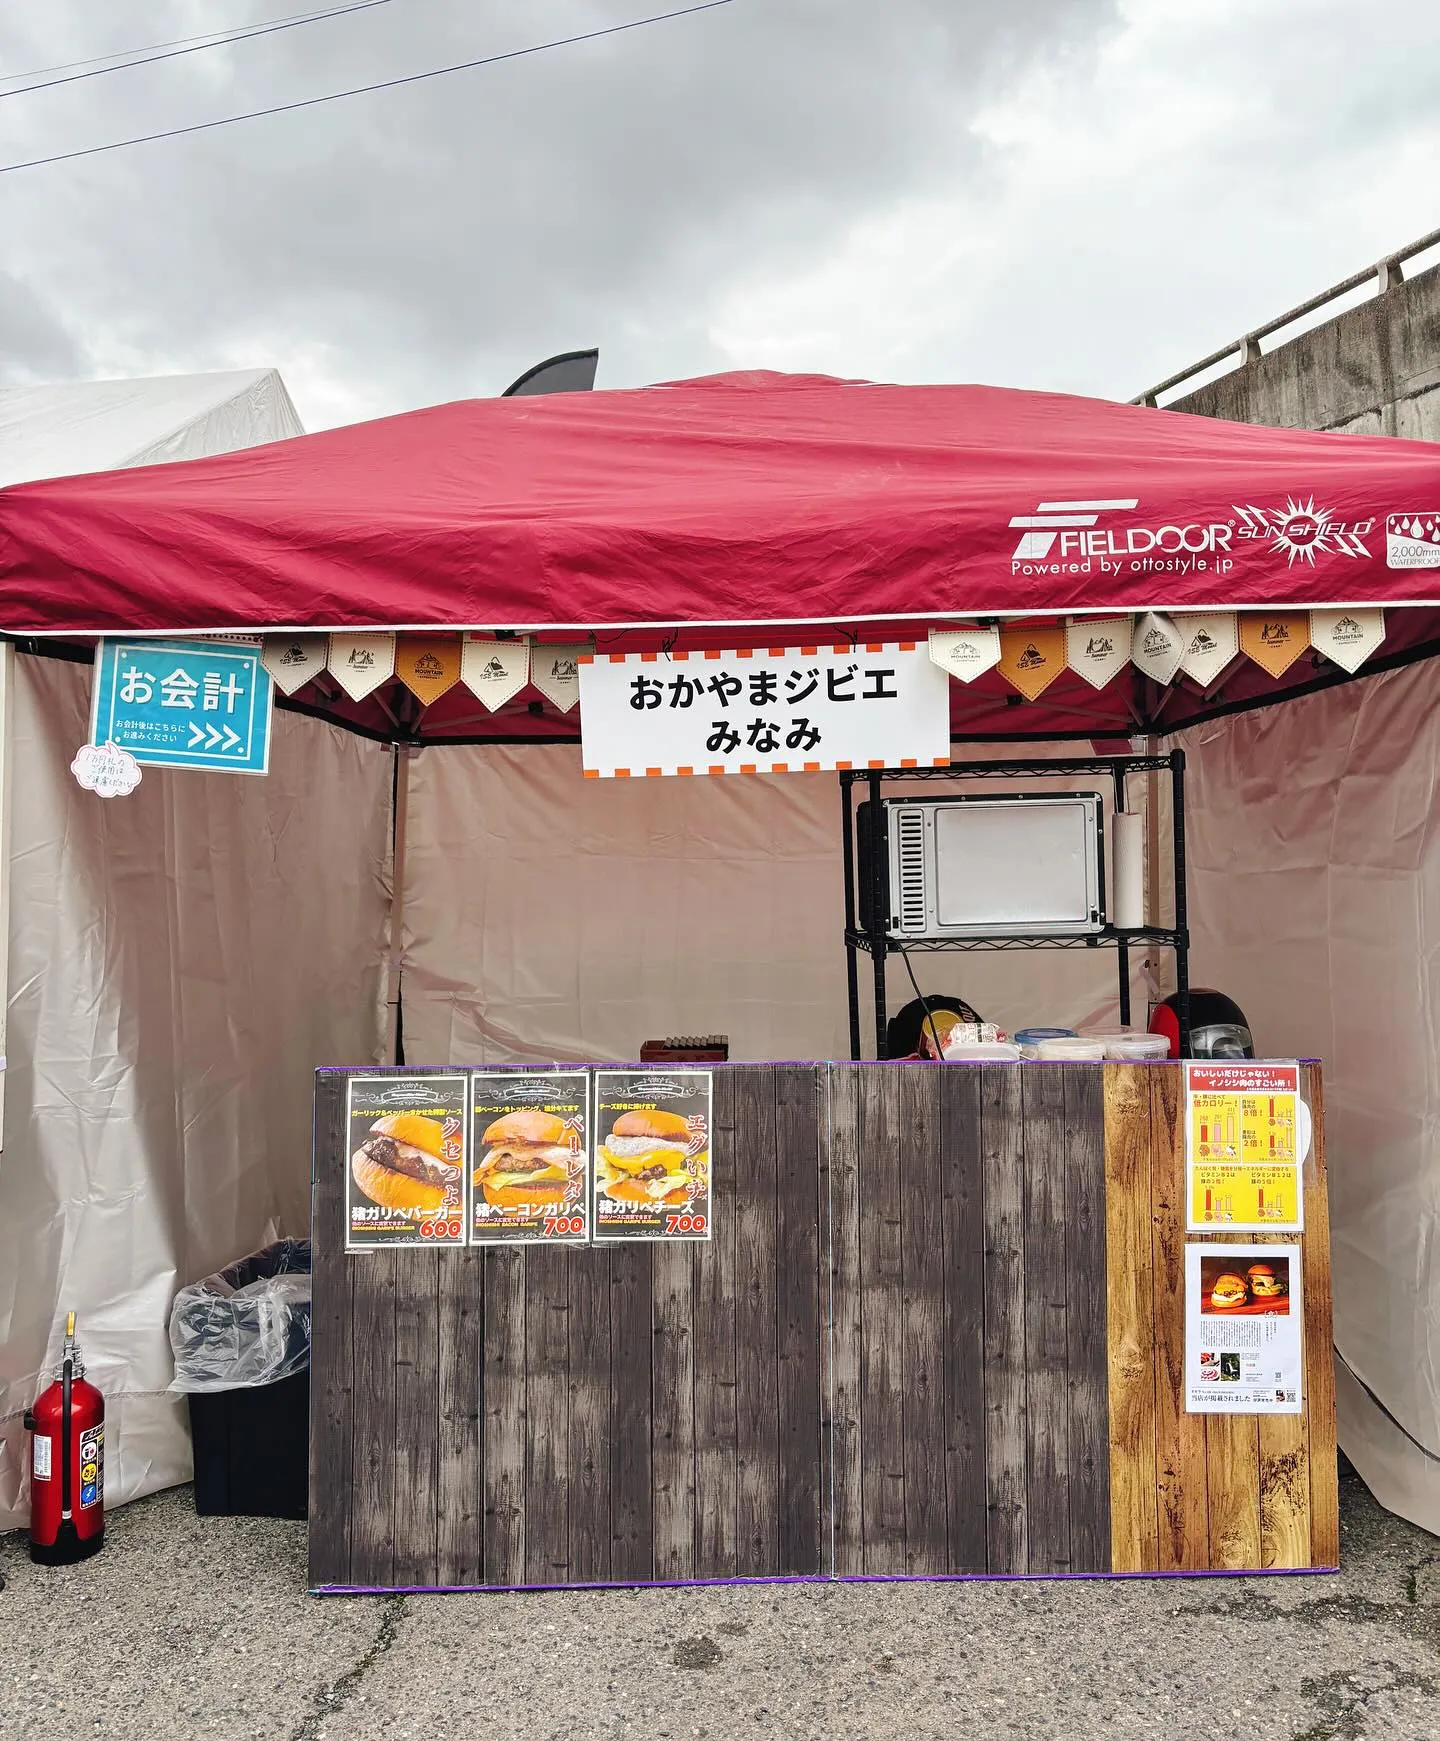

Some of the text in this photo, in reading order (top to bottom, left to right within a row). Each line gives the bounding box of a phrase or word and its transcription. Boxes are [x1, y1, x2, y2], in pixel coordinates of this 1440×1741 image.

[1060, 523, 1232, 557] FIELDOOR
[1391, 545, 1440, 558] 2,000mm
[1011, 555, 1233, 576] Powered by ottostyle.jp
[1144, 643, 1172, 653] MOUNTAIN
[415, 668, 444, 676] MOUNTAIN
[119, 666, 245, 714] お会計
[629, 663, 898, 711] おかやまジビエ
[115, 719, 186, 733] お会計後はこちらに
[123, 730, 177, 743] お進みください
[706, 717, 822, 755] みなみ
[351, 1206, 463, 1221] 猪ガリペバーガー
[475, 1202, 586, 1217] 猪ベーコンガリペ
[599, 1199, 695, 1215] 猪ガリペチーズ
[420, 1219, 463, 1239] 600
[543, 1216, 584, 1237] 700
[666, 1214, 707, 1235] 700
